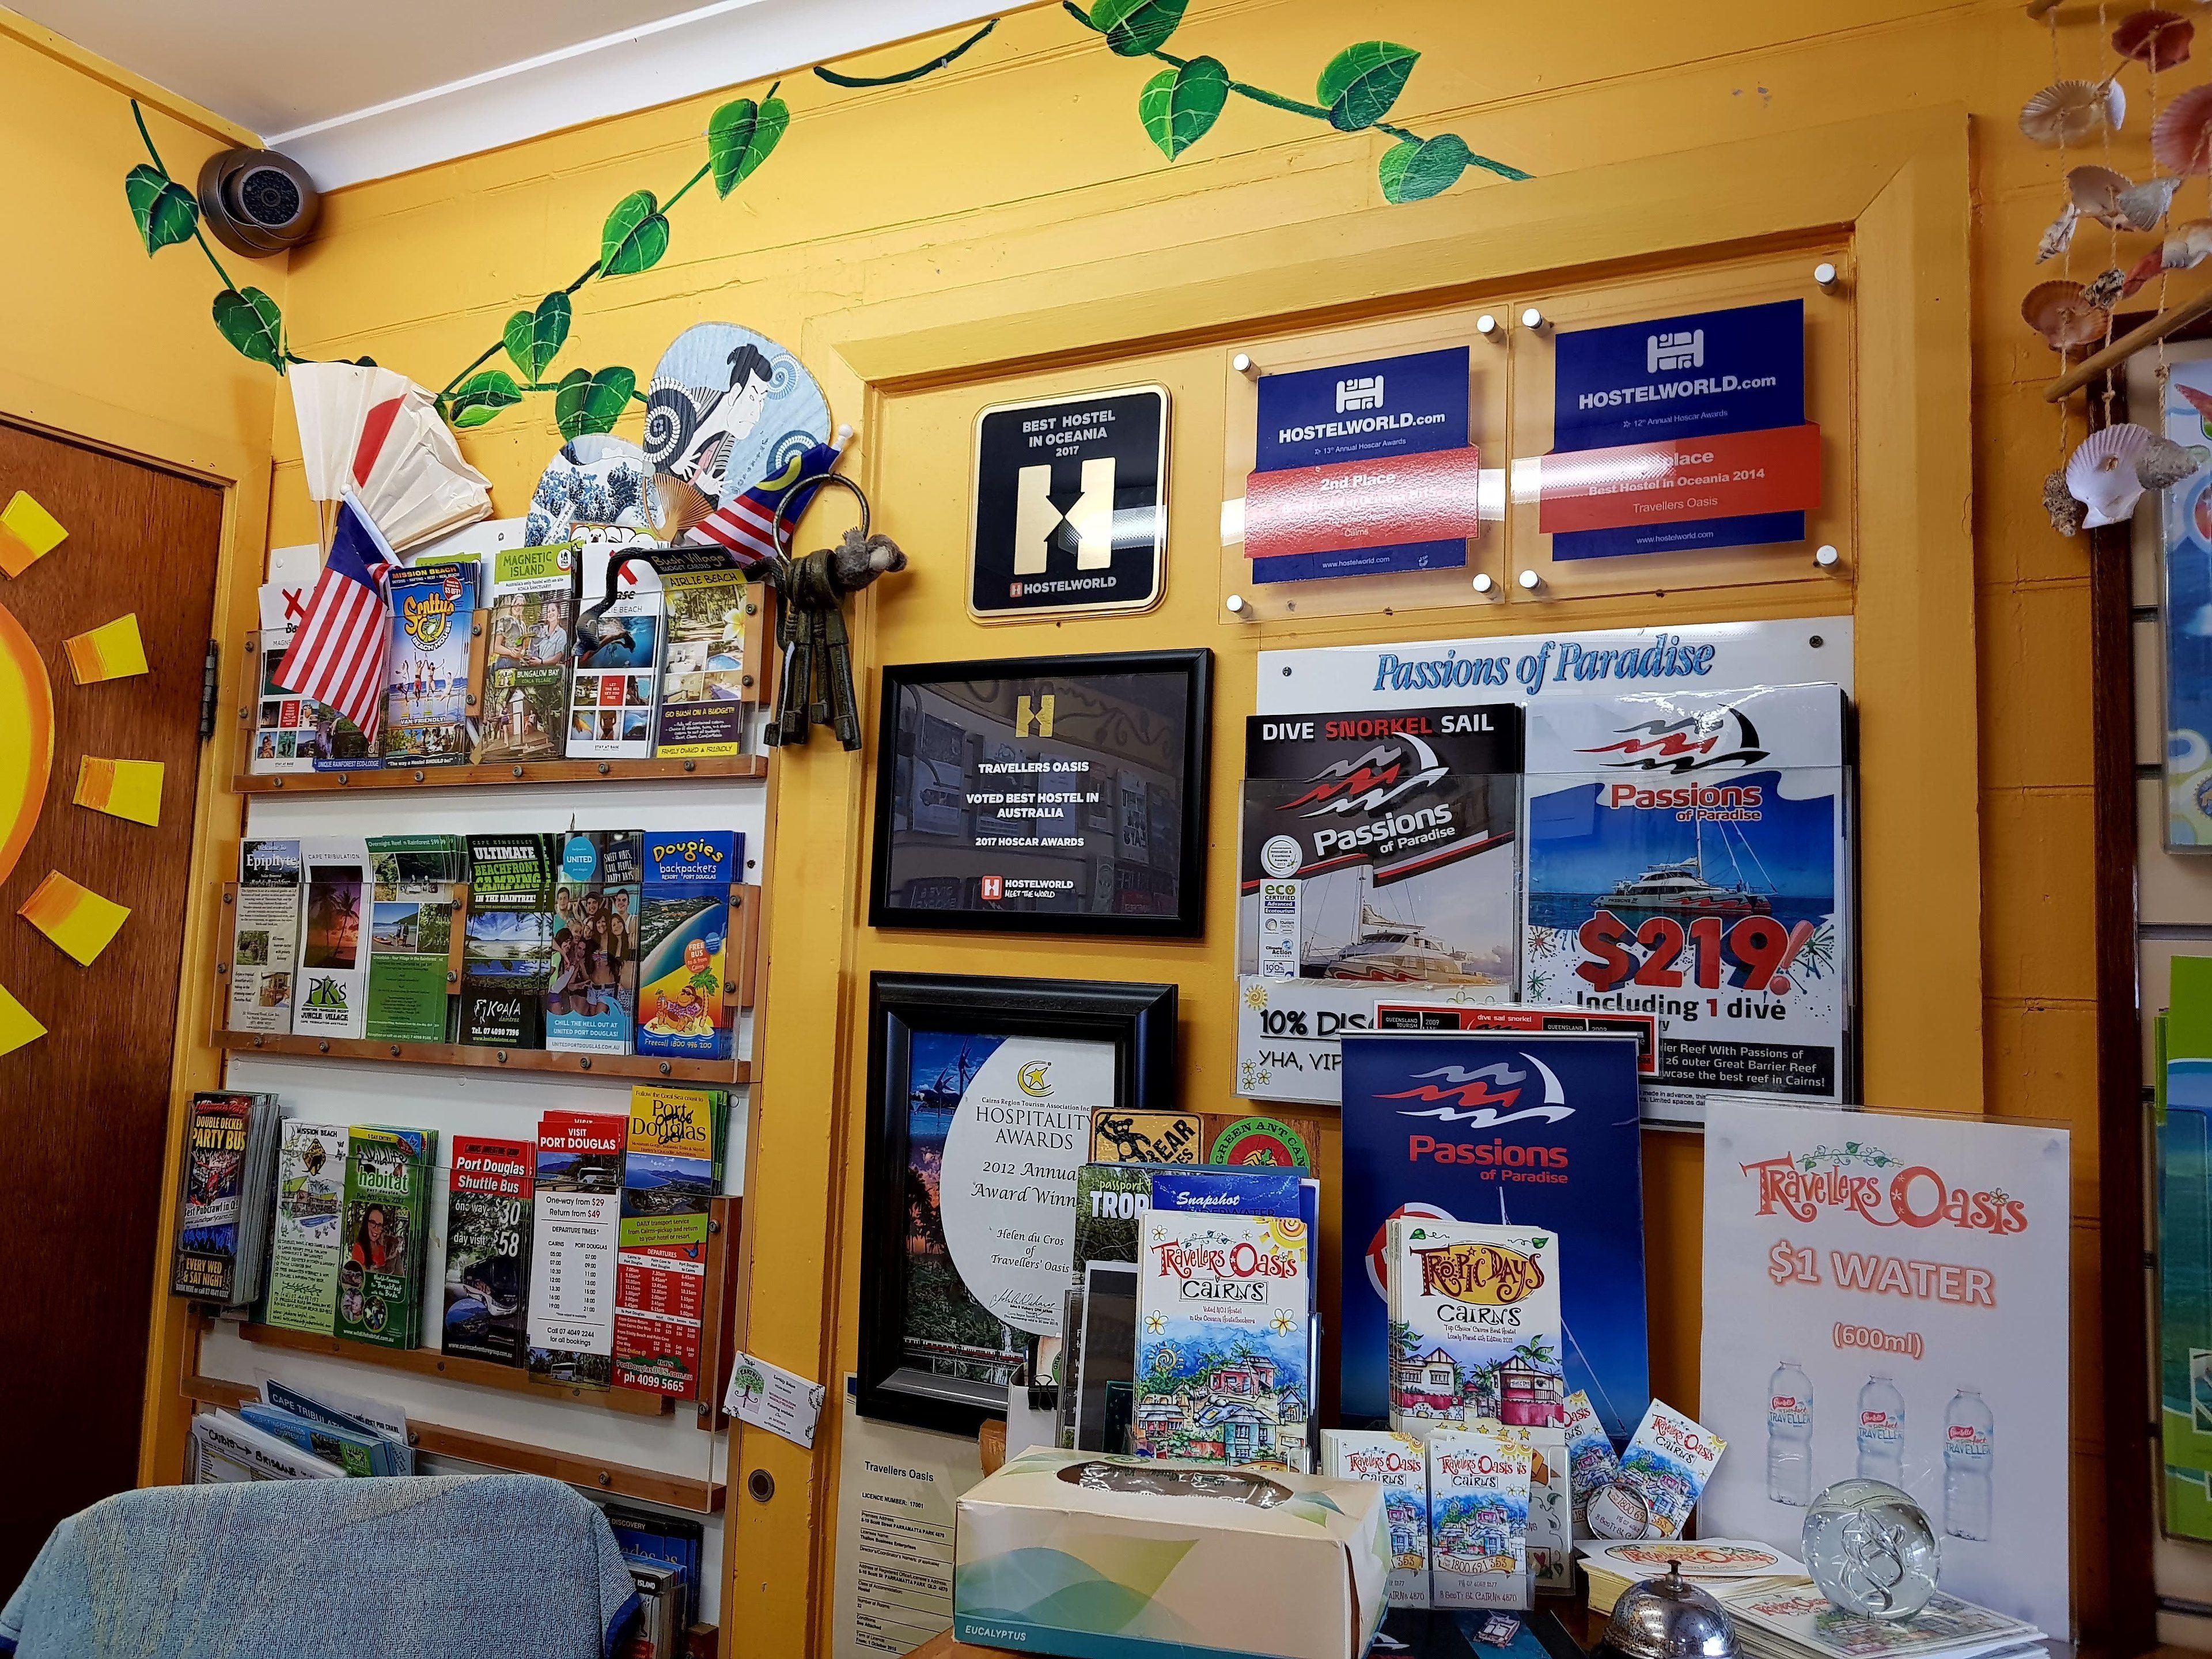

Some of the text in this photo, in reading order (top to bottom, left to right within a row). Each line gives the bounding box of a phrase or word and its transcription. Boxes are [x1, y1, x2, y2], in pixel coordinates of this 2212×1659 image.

[1580, 375, 1776, 410] HOSTELWORLD.com
[1022, 410, 1116, 433] BEST HOSTEL
[1279, 412, 1445, 444] HOSTELWORLD.com
[1029, 427, 1107, 448] IN OCEANIA
[1056, 446, 1080, 457] 2017
[1320, 474, 1396, 491] 2nd Place
[1589, 468, 1765, 496] Best Hostel in Oceania 2014
[1633, 496, 1718, 513] Travellers Oasis
[1636, 530, 1714, 544] www.hostelworld.com
[503, 551, 552, 566] MAGNETIC
[1322, 556, 1390, 569] www.hostelworld.com
[392, 570, 427, 578] MISSION
[510, 564, 545, 577] ISLAND
[670, 573, 738, 586] AIRLIE BEACH
[1024, 577, 1116, 594] HOSTELWORLD
[619, 605, 642, 613] BEACH
[1373, 632, 1715, 695] Passions of Paradise
[1263, 713, 1494, 741] DIVE SNORKEL SAIL
[979, 762, 1089, 774] TRAVELLERS OASIS
[966, 793, 1099, 805] VOTED BEST HOSTEL IN
[1609, 782, 1763, 809] Passions
[997, 808, 1064, 818] AUSTRALIA
[1677, 809, 1762, 821] of Paradise
[1313, 803, 1453, 857] Passions
[976, 837, 1085, 846] 2017 HOSCAR AWARDS
[1380, 825, 1456, 855] of Paradise
[474, 847, 535, 861] ULTIMATE
[654, 838, 724, 862] Dougies
[566, 855, 593, 863] UNITED
[475, 861, 539, 877] BEACHFRONT
[660, 863, 717, 875] backpackers
[474, 873, 541, 892] CAMPING
[1005, 880, 1074, 889] HOSTELWORLD
[475, 894, 536, 903] IN THE DAINTREE!
[689, 942, 704, 952] FREE
[691, 950, 703, 958] BUS
[1577, 991, 1786, 1022] Including 1 dive
[325, 1013, 349, 1021] VILLAGE
[1259, 1009, 1307, 1035] 10%
[554, 1028, 573, 1036] UNITED
[1680, 1044, 1803, 1059] Reef With Passions of
[1681, 1058, 1710, 1067] outer
[1714, 1059, 1744, 1069] Great
[1748, 1060, 1786, 1071] Barrier
[1790, 1063, 1817, 1073] Reef
[1660, 1070, 1824, 1087] wcase the best reef in Cairns!
[652, 1100, 687, 1117] Port
[1047, 1103, 1079, 1111] Association
[632, 1118, 706, 1143] Douglas
[192, 1127, 246, 1151] PARTY BUS
[541, 1138, 616, 1150] PORT DOUGLAS
[995, 1128, 1073, 1150] AWARDS
[1215, 1122, 1252, 1165] GREEN
[1255, 1122, 1288, 1138] ANT
[1409, 1134, 1569, 1168] Passions
[457, 1157, 524, 1176] Port Douglas
[983, 1161, 1077, 1181] 2012 Annua
[358, 1165, 409, 1191] habitat
[459, 1176, 519, 1193] Shuttle Bus
[1480, 1170, 1569, 1184] of Paradise
[1099, 1180, 1144, 1193] passport
[1739, 1150, 2028, 1236] Travellers Oasis
[546, 1196, 574, 1206] One-way
[592, 1199, 604, 1207] $29
[971, 1184, 1077, 1207] Award Winn
[1176, 1191, 1240, 1207] Snapshot
[588, 1210, 600, 1218] $49
[647, 1249, 677, 1257] DEPARTURES
[1150, 1237, 1297, 1279] Travellers Oasis
[186, 1258, 222, 1274] EVERY WED
[991, 1253, 1070, 1273] Travellers' Oasis
[1768, 1240, 1996, 1308] $1 WATER
[1833, 1322, 1925, 1359] (600ml)
[624, 1373, 684, 1392] ph 4099 5665
[865, 1461, 934, 1482] Travellers Oasis
[862, 1493, 883, 1501] LICENCE
[885, 1497, 907, 1506] NUMBER:
[612, 1518, 646, 1530] DISCOVERY
[637, 1579, 656, 1590] ISLAND
[965, 1625, 1027, 1642] EUCALYPTUS
